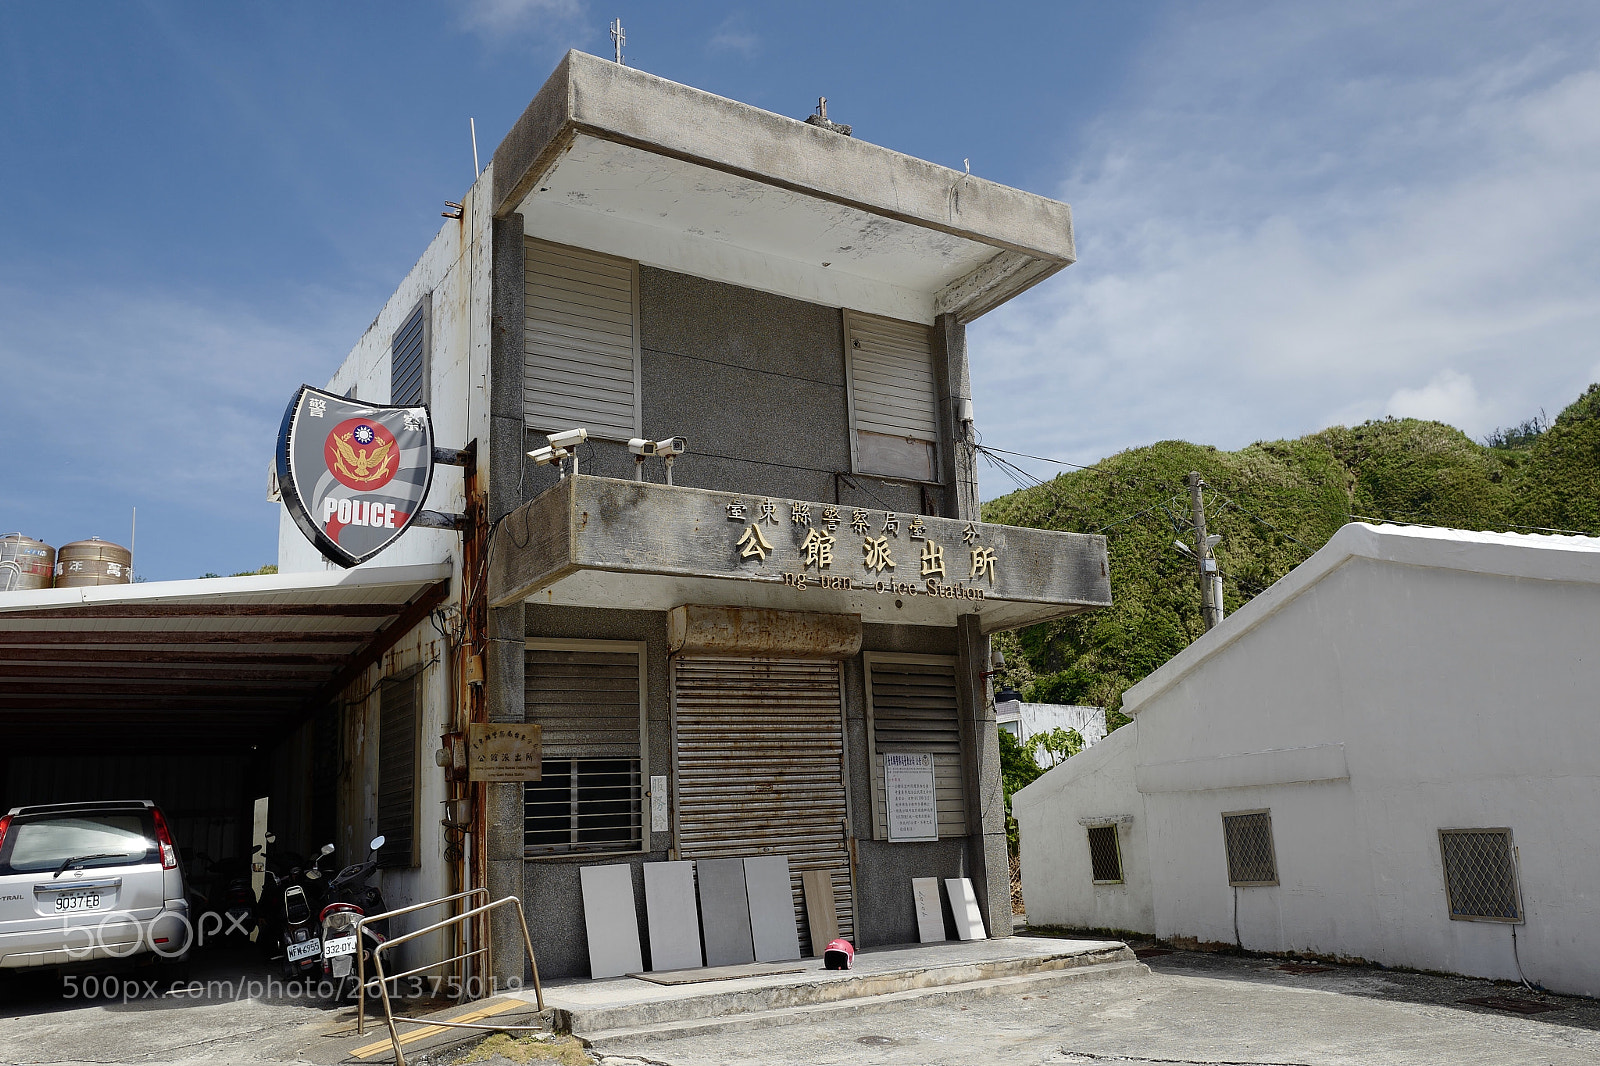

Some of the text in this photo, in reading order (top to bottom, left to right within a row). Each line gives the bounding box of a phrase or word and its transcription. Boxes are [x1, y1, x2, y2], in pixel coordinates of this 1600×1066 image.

[308, 398, 327, 419] 警
[323, 496, 396, 529] POLICE
[736, 522, 999, 585] 公館派出所
[925, 577, 986, 602] Station
